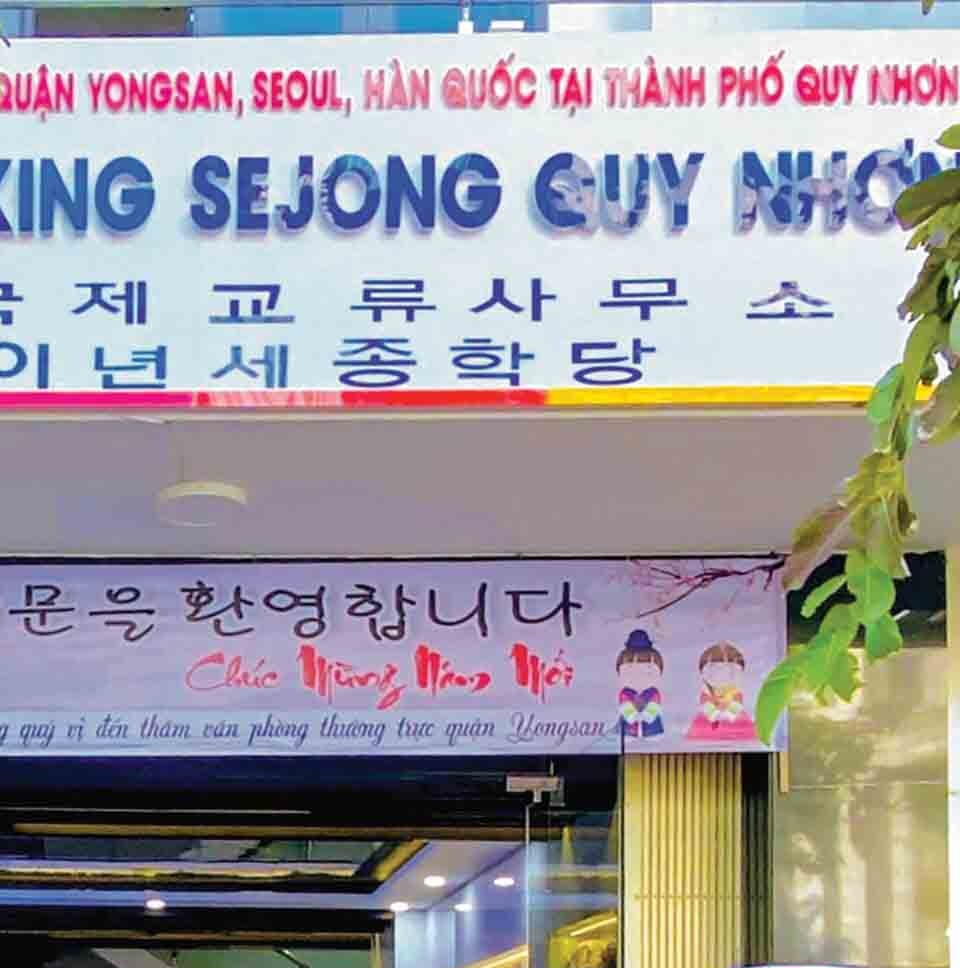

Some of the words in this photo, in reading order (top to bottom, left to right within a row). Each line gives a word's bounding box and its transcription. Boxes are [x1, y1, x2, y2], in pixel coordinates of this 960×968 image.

[88, 70, 244, 118] YONGSAN,
[253, 69, 351, 117] SEOUL,
[363, 57, 430, 110] HÀN
[442, 52, 537, 110] QUỐC
[549, 67, 593, 117] TẠI
[604, 56, 706, 109] THÀNH
[718, 50, 786, 107] PHỐ
[796, 64, 859, 105] QUY
[190, 153, 503, 235] SEJONG
[534, 151, 705, 234] QUY
[179, 580, 583, 641] 환영합니다
